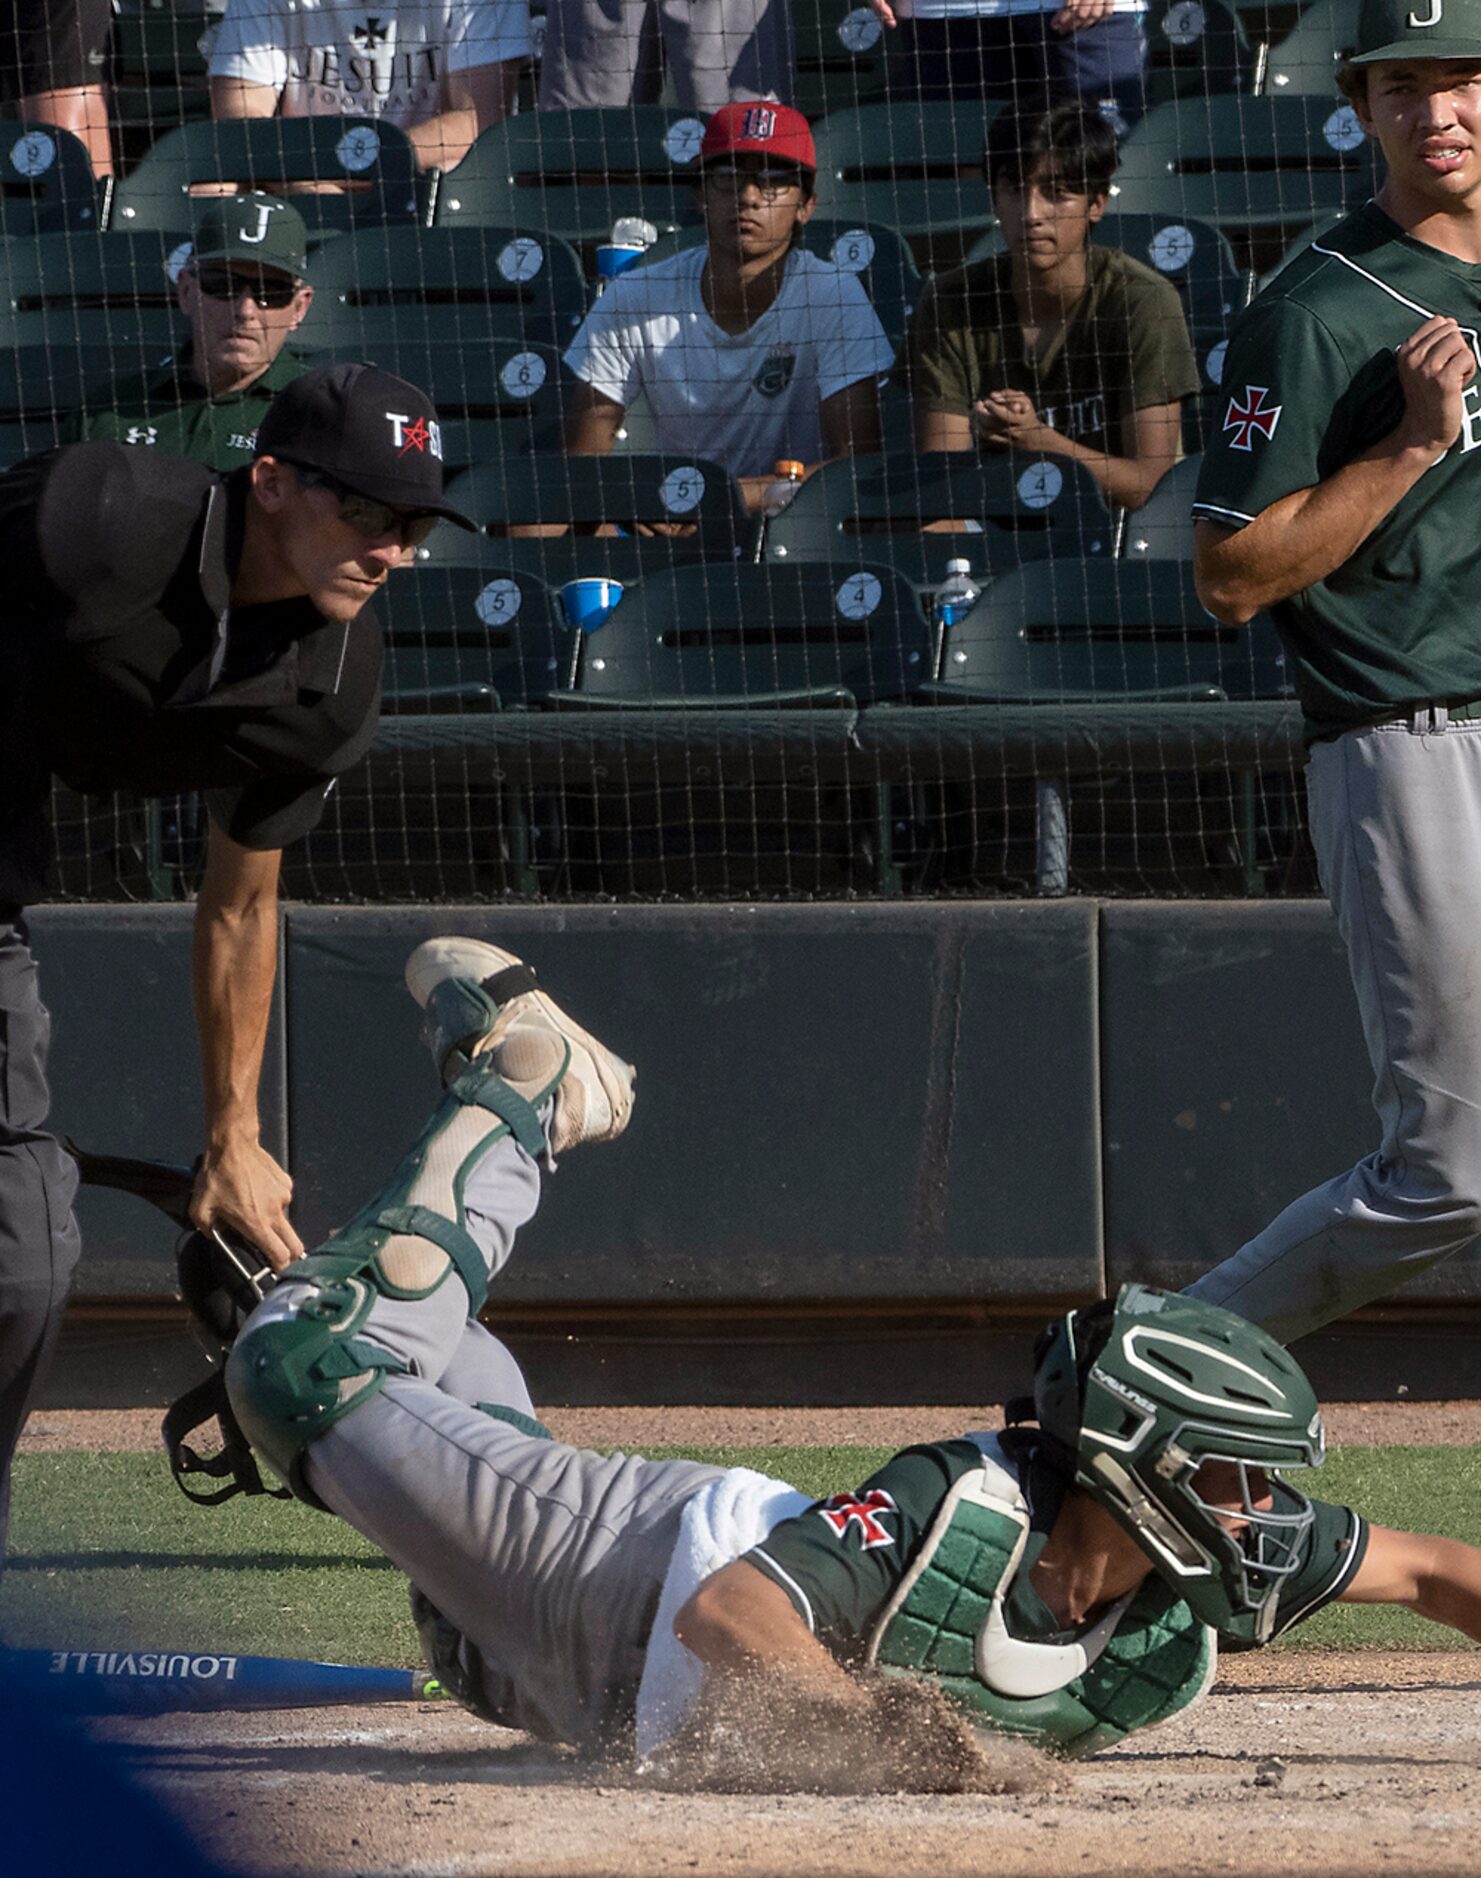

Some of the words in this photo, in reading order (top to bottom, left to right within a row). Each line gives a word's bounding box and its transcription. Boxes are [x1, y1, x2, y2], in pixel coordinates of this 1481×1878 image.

[291, 46, 442, 94] JESUIT
[353, 140, 365, 158] 8
[680, 131, 692, 148] 7
[239, 203, 276, 243] J
[849, 243, 859, 262] 6
[1167, 238, 1178, 254] 5
[516, 251, 529, 270] 7
[519, 365, 530, 384] 6
[677, 481, 689, 499] 5
[1034, 477, 1045, 491] 4
[493, 592, 505, 611] 5
[854, 588, 864, 602] 4
[49, 1651, 239, 1681] LOUISVILLE
